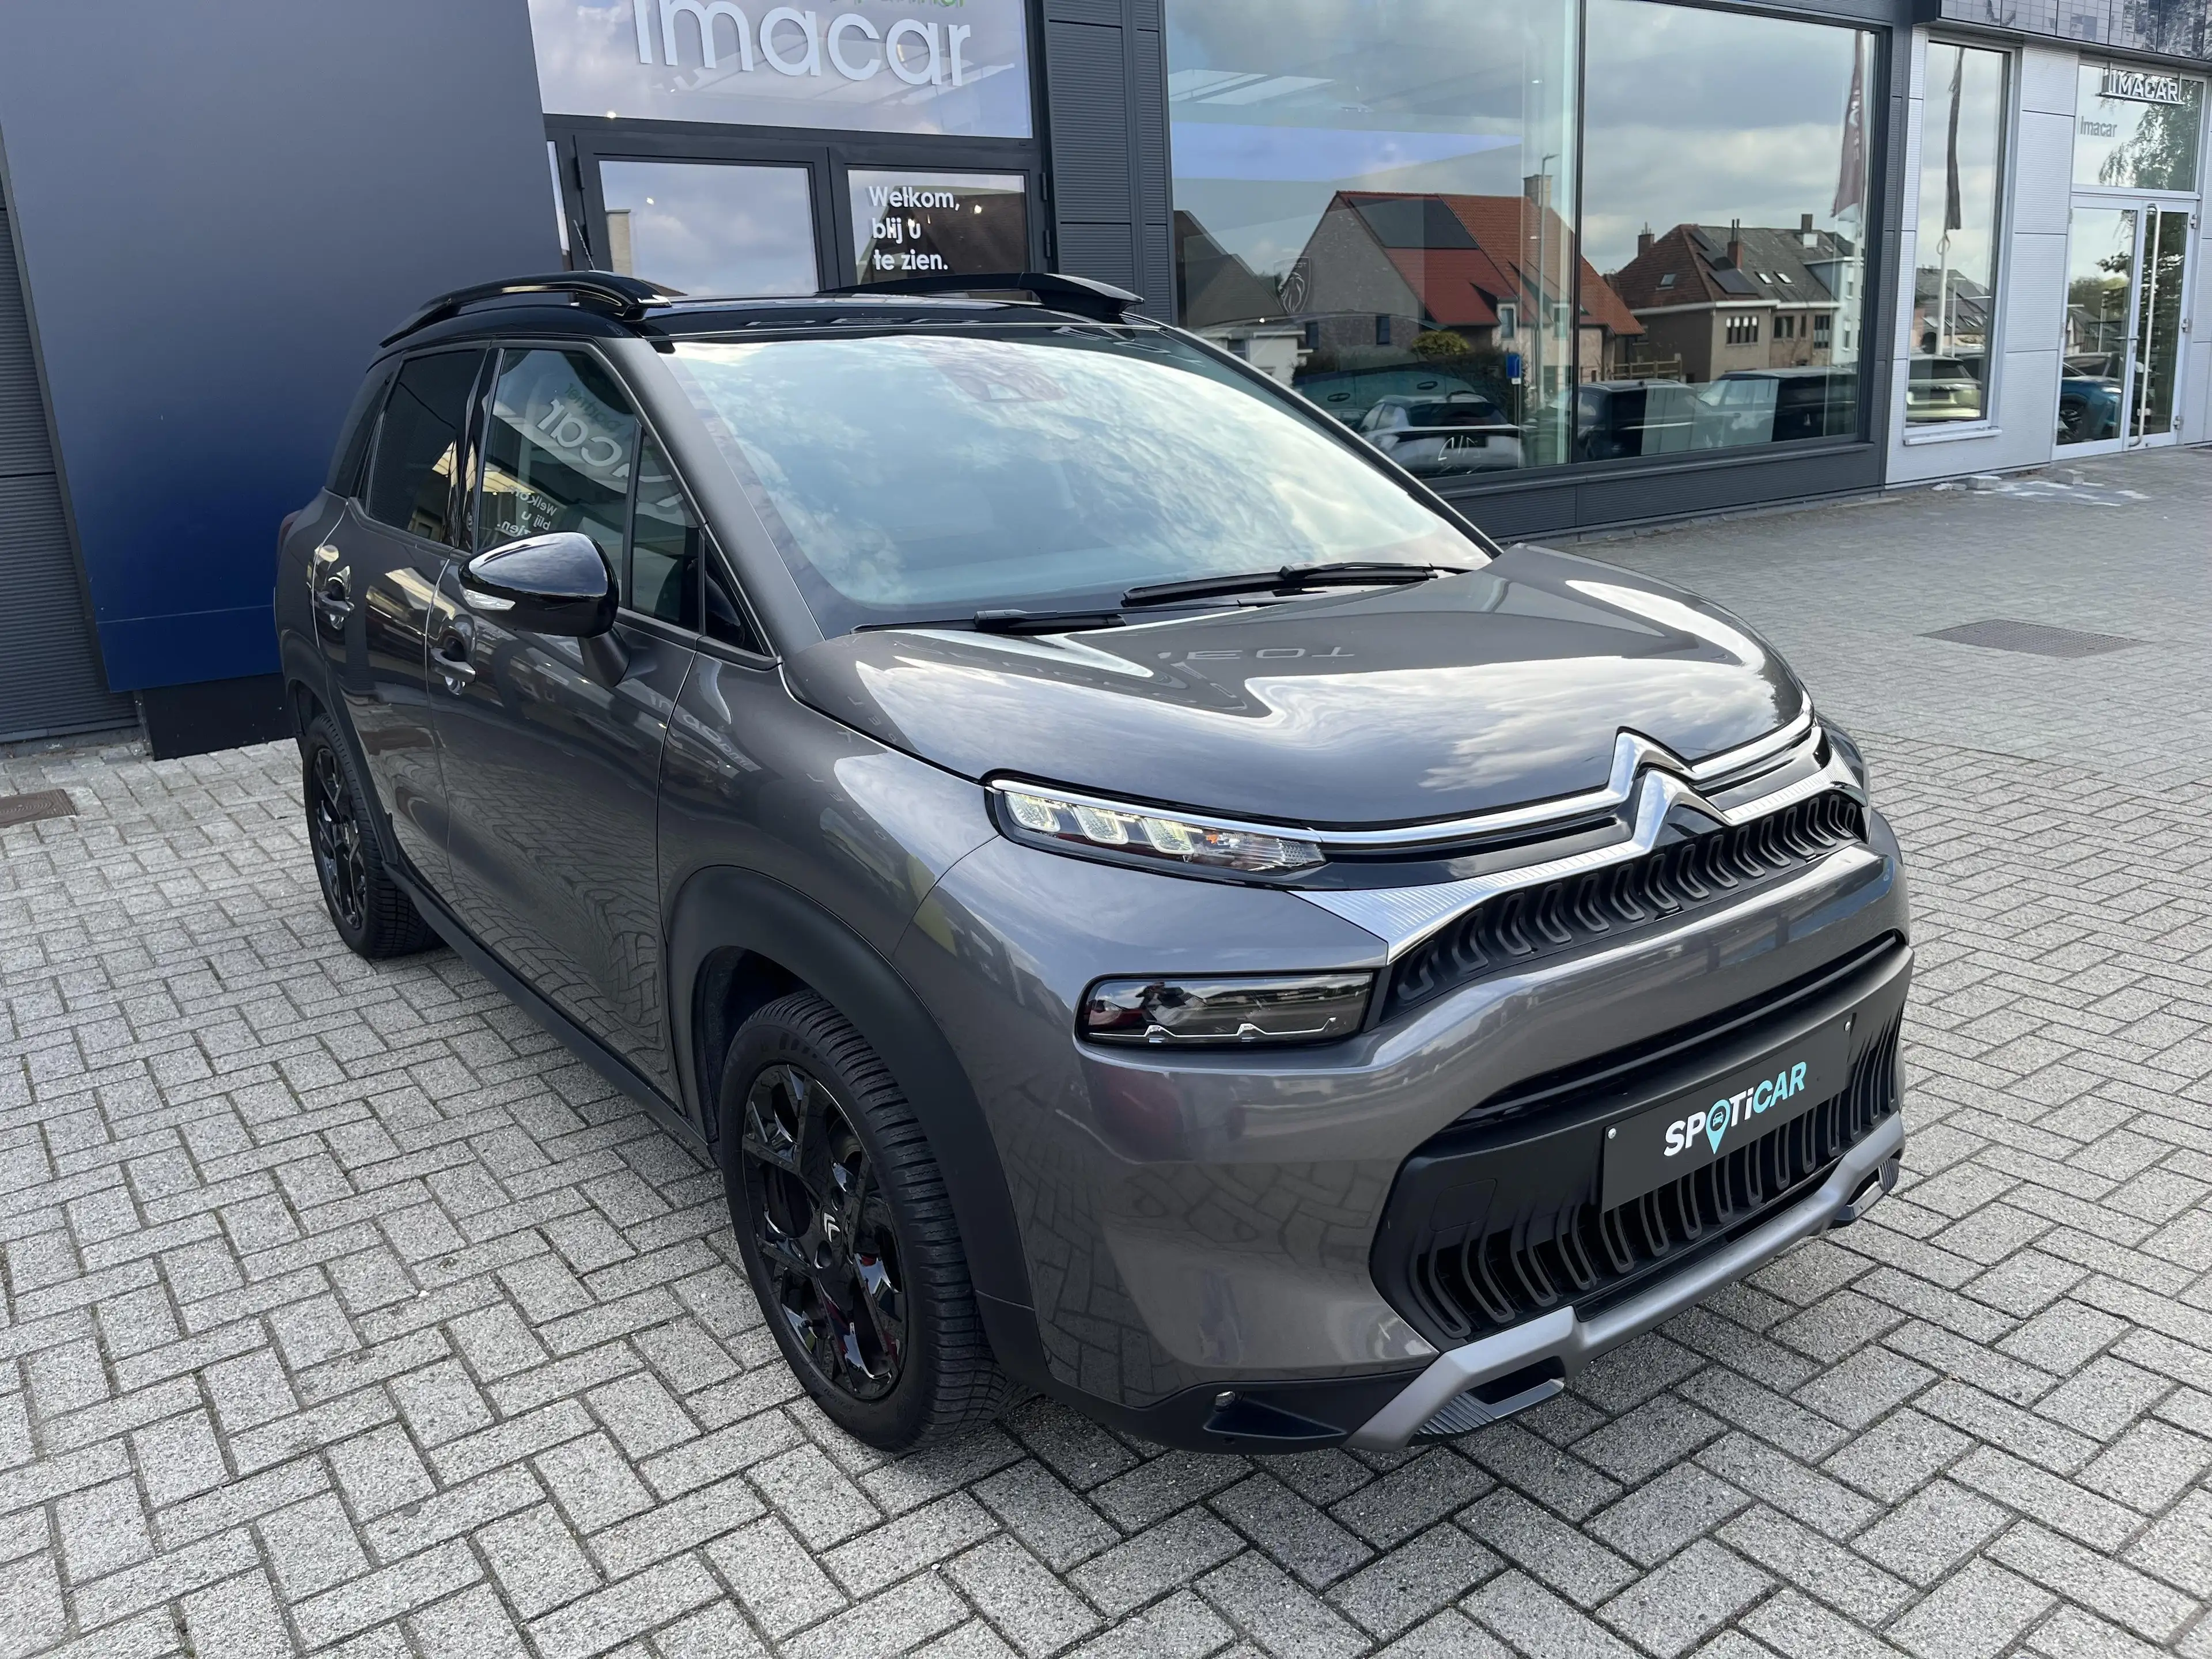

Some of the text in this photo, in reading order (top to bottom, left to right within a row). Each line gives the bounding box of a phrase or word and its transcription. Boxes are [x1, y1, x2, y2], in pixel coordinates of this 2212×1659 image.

[633, 0, 971, 86] Imacar
[2112, 70, 2179, 102] IMACAR
[2080, 116, 2118, 138] Imacar
[868, 186, 960, 211] Welkom,
[872, 217, 921, 244] blij u
[873, 249, 949, 270] te zien.
